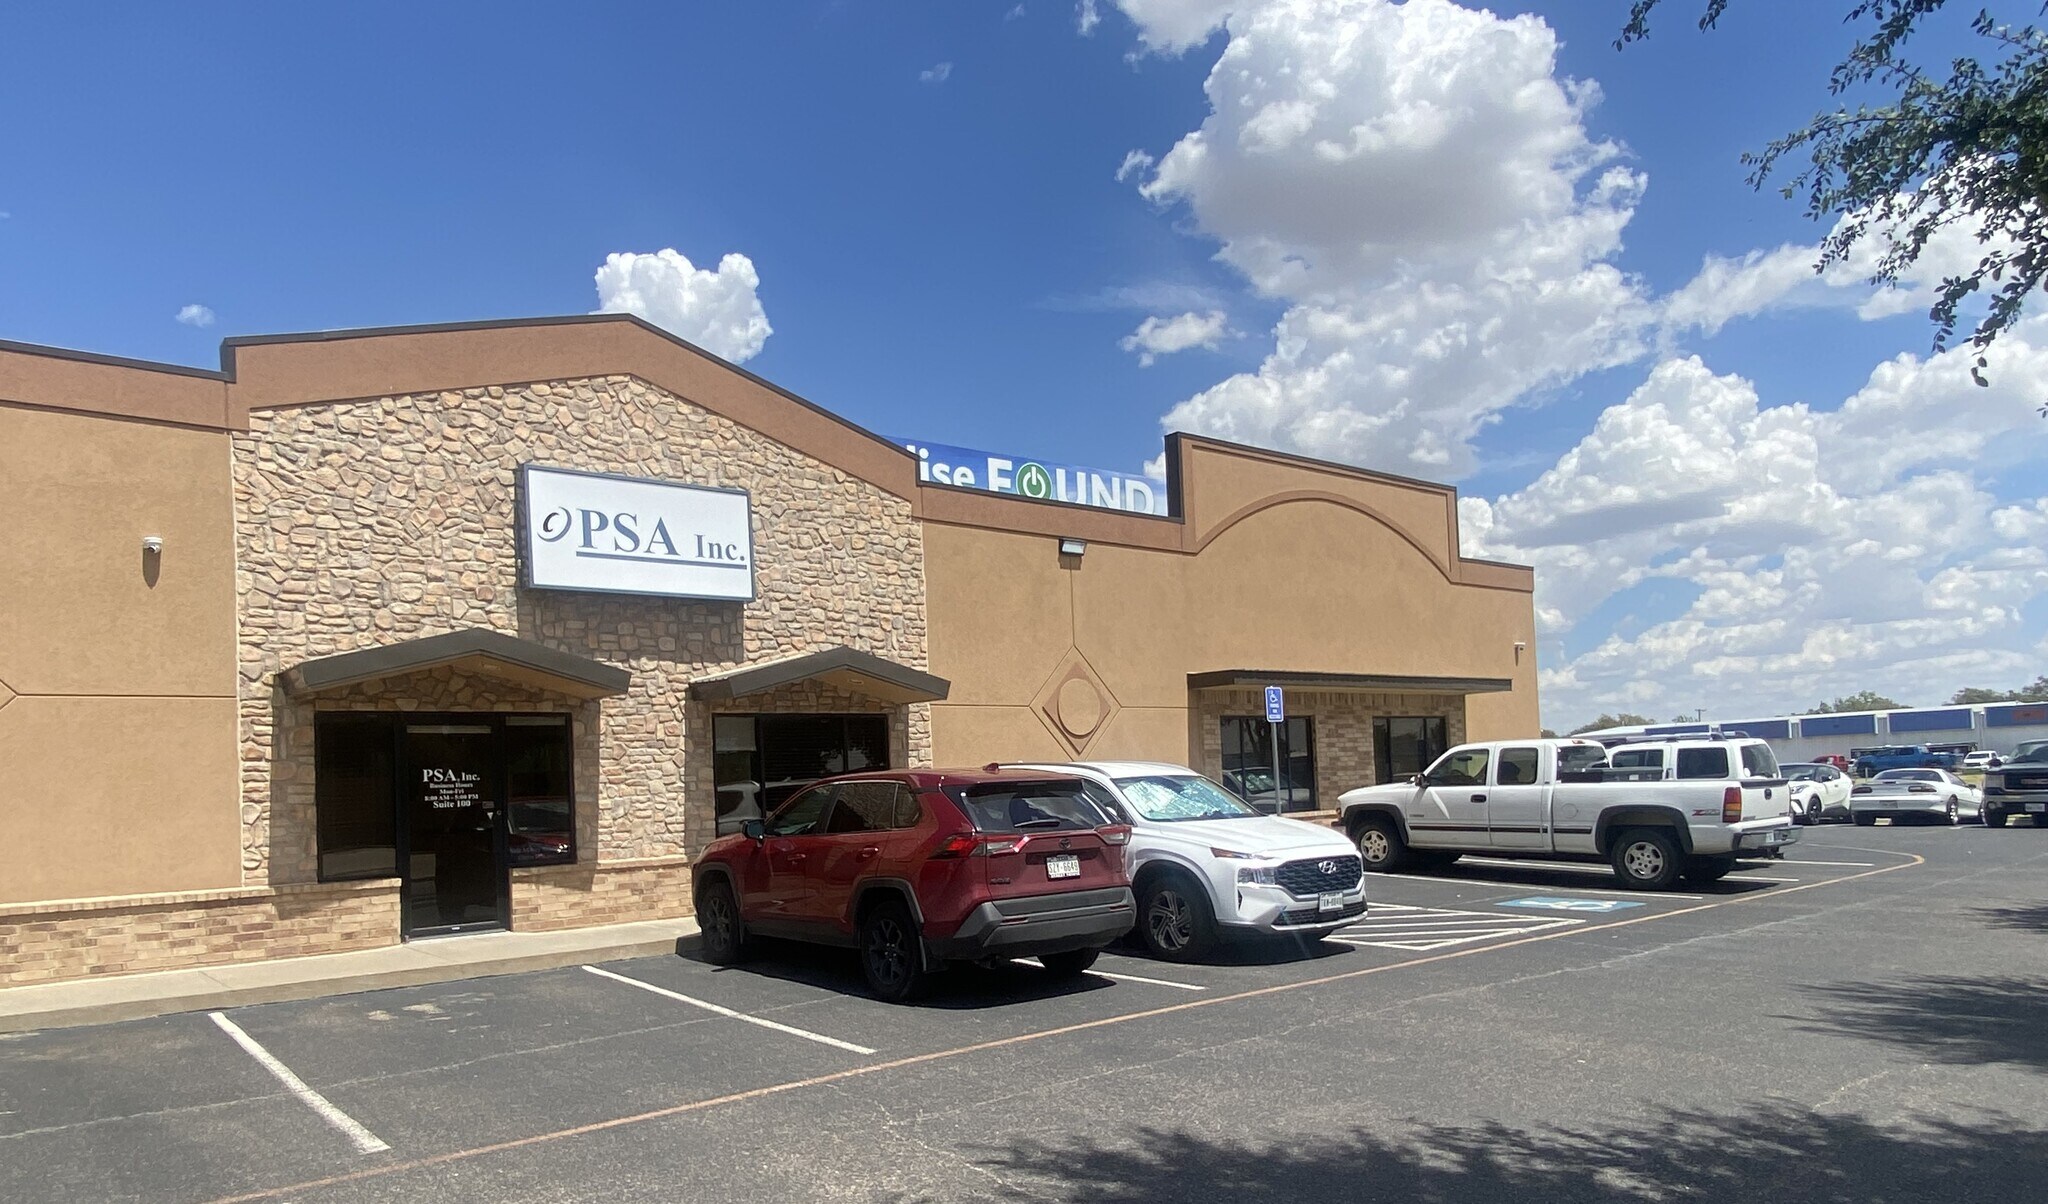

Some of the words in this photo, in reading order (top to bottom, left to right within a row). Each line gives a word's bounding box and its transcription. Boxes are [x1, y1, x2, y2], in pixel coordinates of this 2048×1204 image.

[906, 444, 976, 487] ise
[576, 508, 682, 556] PSA
[694, 533, 745, 562] Inc.
[461, 771, 481, 781] Inc.
[433, 800, 455, 808] Suite
